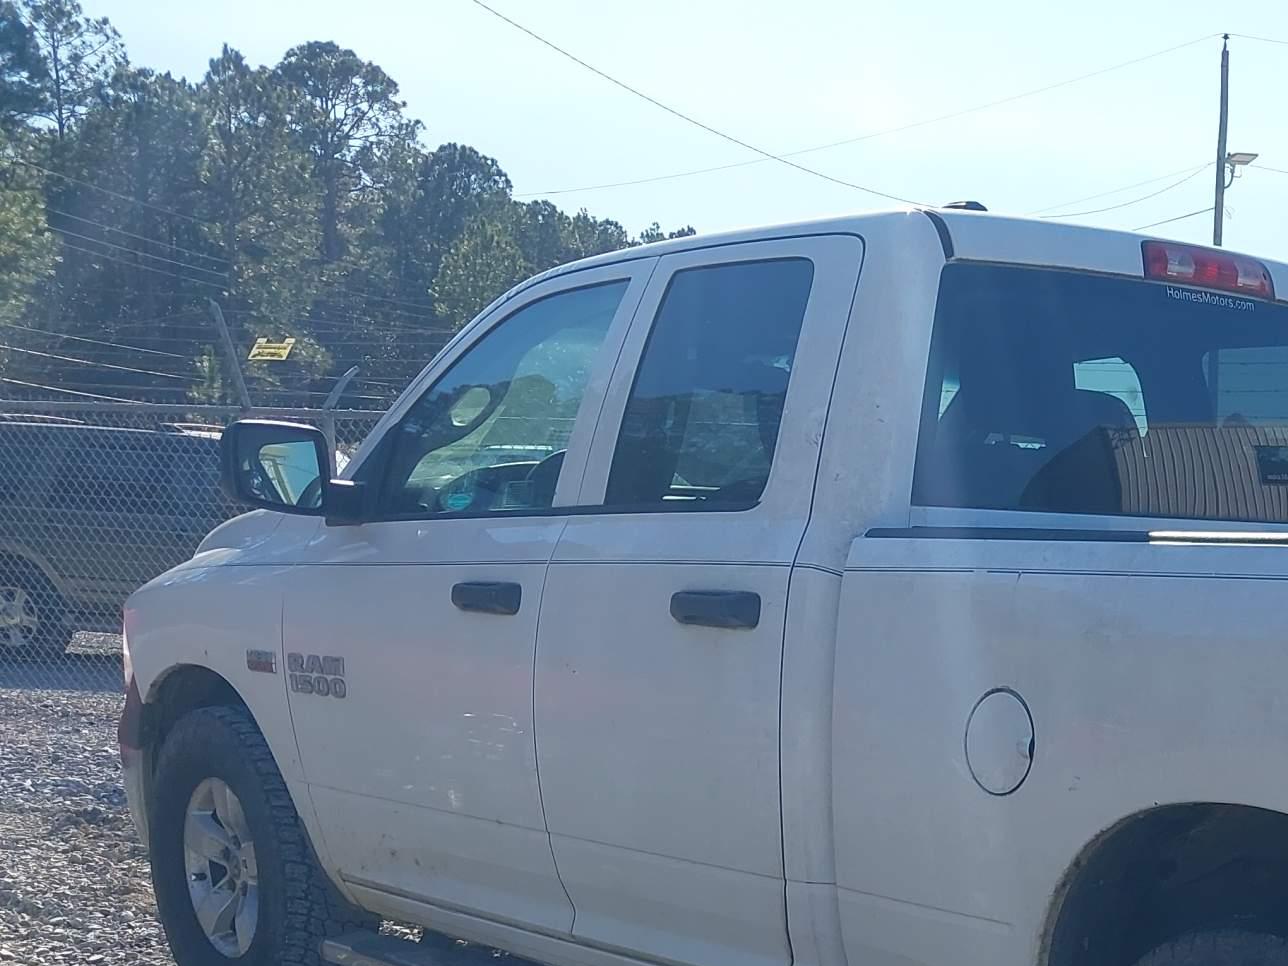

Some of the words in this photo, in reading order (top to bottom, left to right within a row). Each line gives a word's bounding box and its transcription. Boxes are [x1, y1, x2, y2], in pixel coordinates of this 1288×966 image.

[1166, 285, 1255, 312] HolmesMotors.com
[287, 652, 345, 677] RAM
[289, 673, 347, 699] 1500
